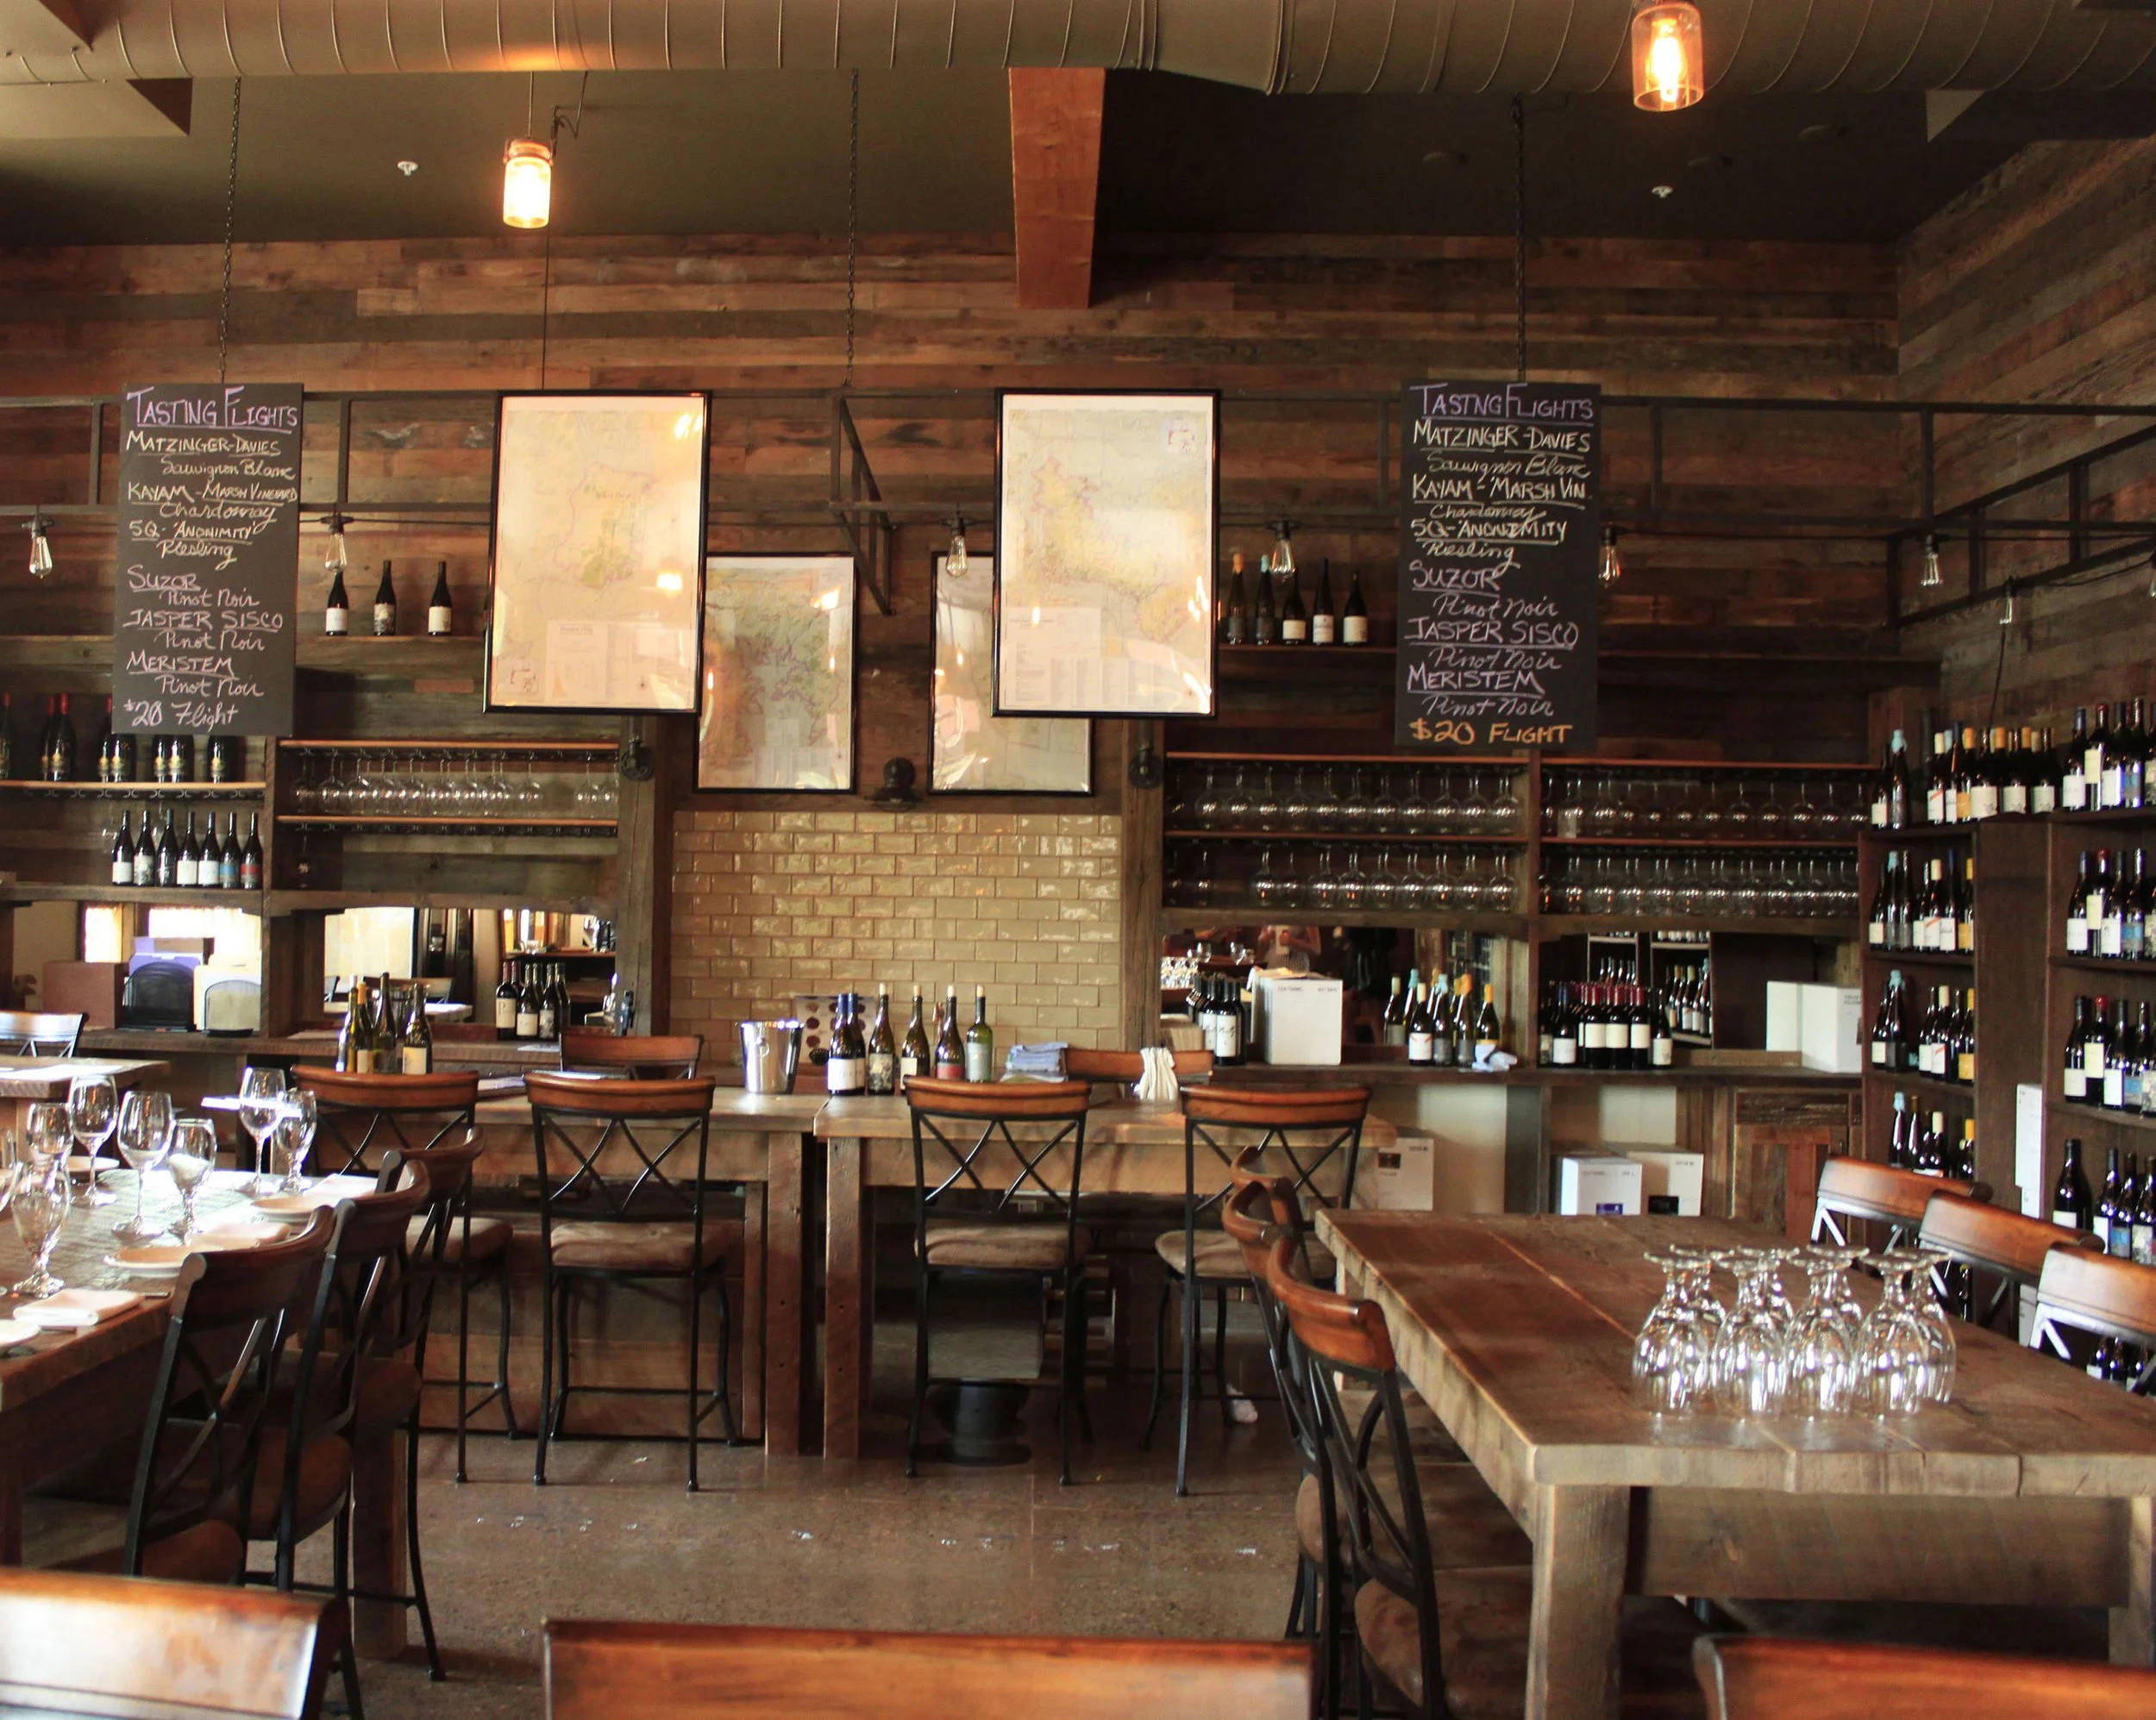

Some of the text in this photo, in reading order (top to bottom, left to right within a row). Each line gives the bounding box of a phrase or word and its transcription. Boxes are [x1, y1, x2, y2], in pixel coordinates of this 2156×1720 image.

[127, 386, 298, 427] TASTING FLIGHTS
[1506, 383, 1594, 420] FLIGHTS
[240, 458, 296, 480] Blanc
[1526, 453, 1591, 478] Blanc
[128, 481, 195, 503] KAYAM
[1413, 473, 1474, 500] KAYAM
[128, 564, 201, 590] SUZOR
[1409, 560, 1501, 591] SUZOR
[160, 589, 212, 607] Pinot
[1432, 593, 1501, 620] Pinot
[122, 609, 283, 631] JASPER SISCO
[1404, 616, 1579, 647] JASPER SISCO
[154, 630, 216, 650] Pinot
[126, 649, 235, 677] MERISTEM
[1427, 647, 1500, 669] Pinot
[154, 675, 211, 697] Pinot
[1407, 662, 1545, 695] MERISTEM
[123, 699, 239, 732] $20 Flight
[1421, 693, 1496, 716] Pinot
[1409, 717, 1573, 745] $20 FLIGHT
